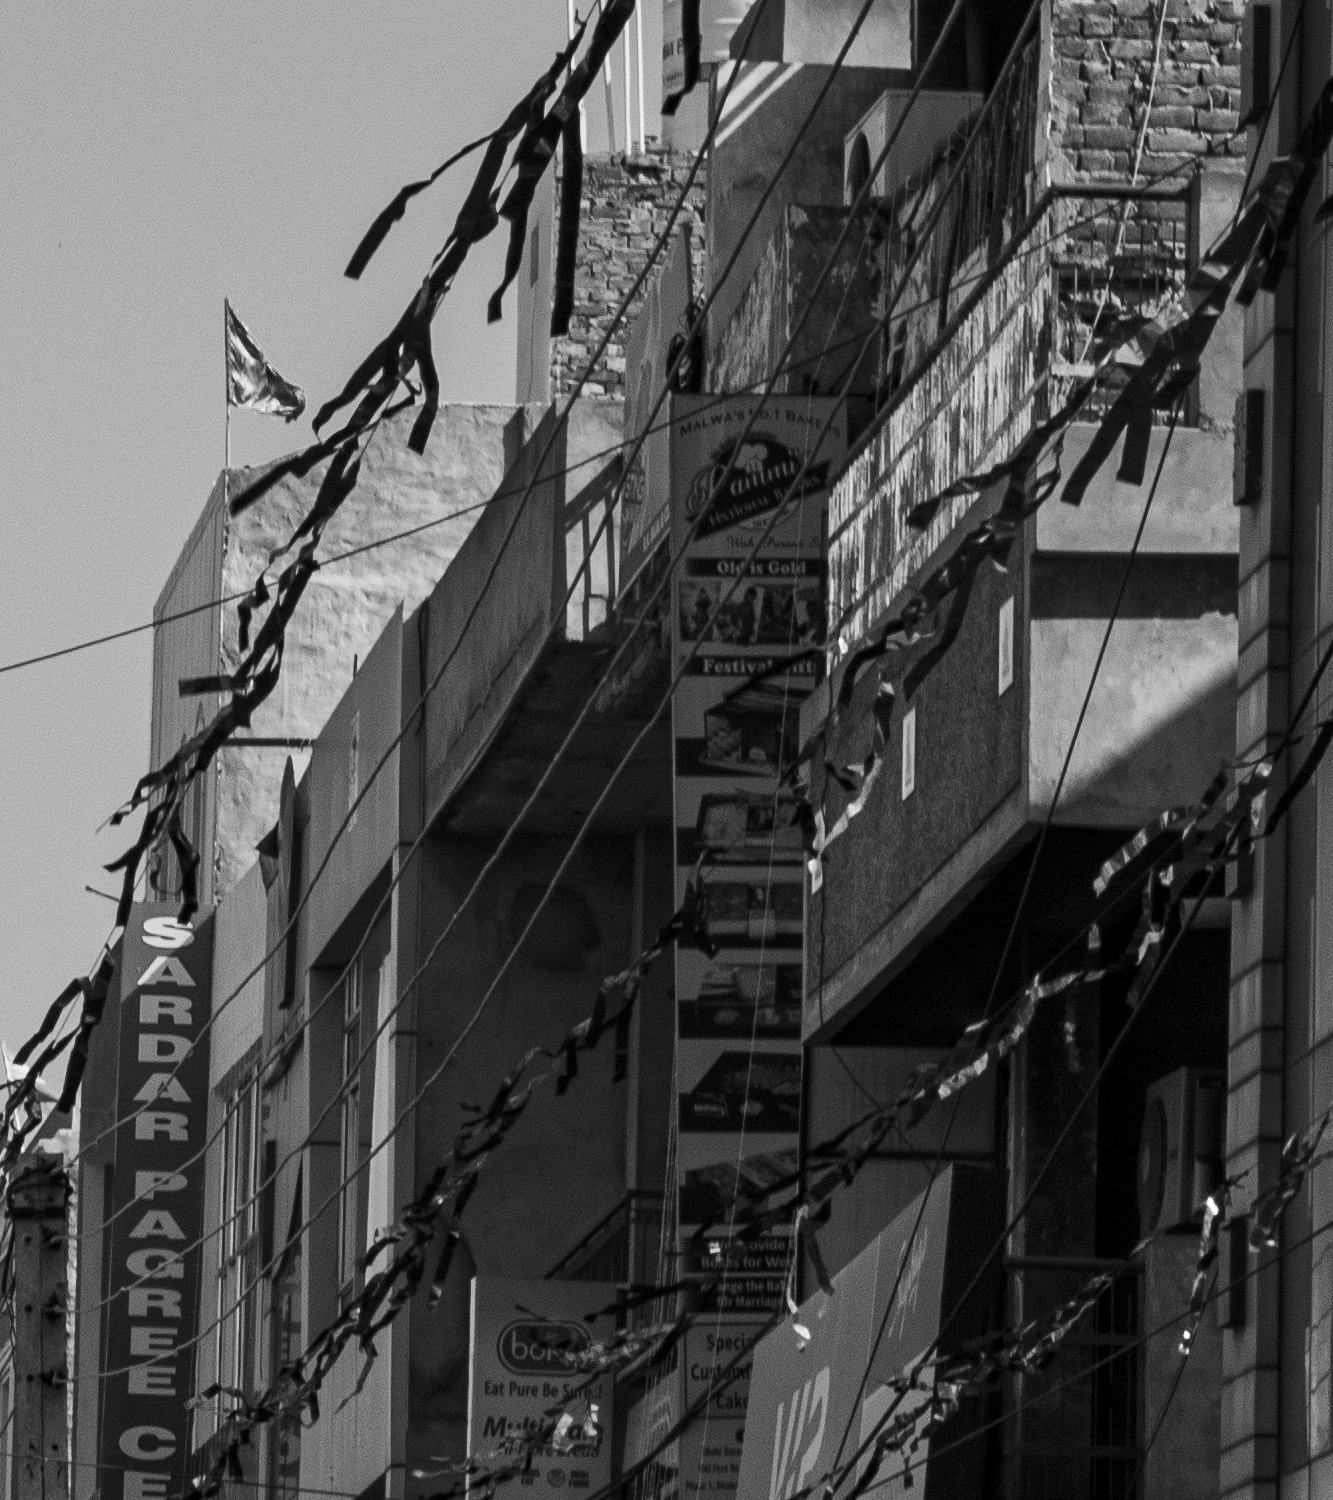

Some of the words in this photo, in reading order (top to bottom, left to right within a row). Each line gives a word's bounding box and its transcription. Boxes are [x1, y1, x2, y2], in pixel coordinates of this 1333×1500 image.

[768, 560, 806, 575] Gold
[133, 916, 197, 1142] SARDAR
[126, 1169, 187, 1397] PAGREE
[484, 1380, 505, 1397] Eat
[508, 1381, 539, 1397] Pure
[542, 1381, 558, 1398] Be
